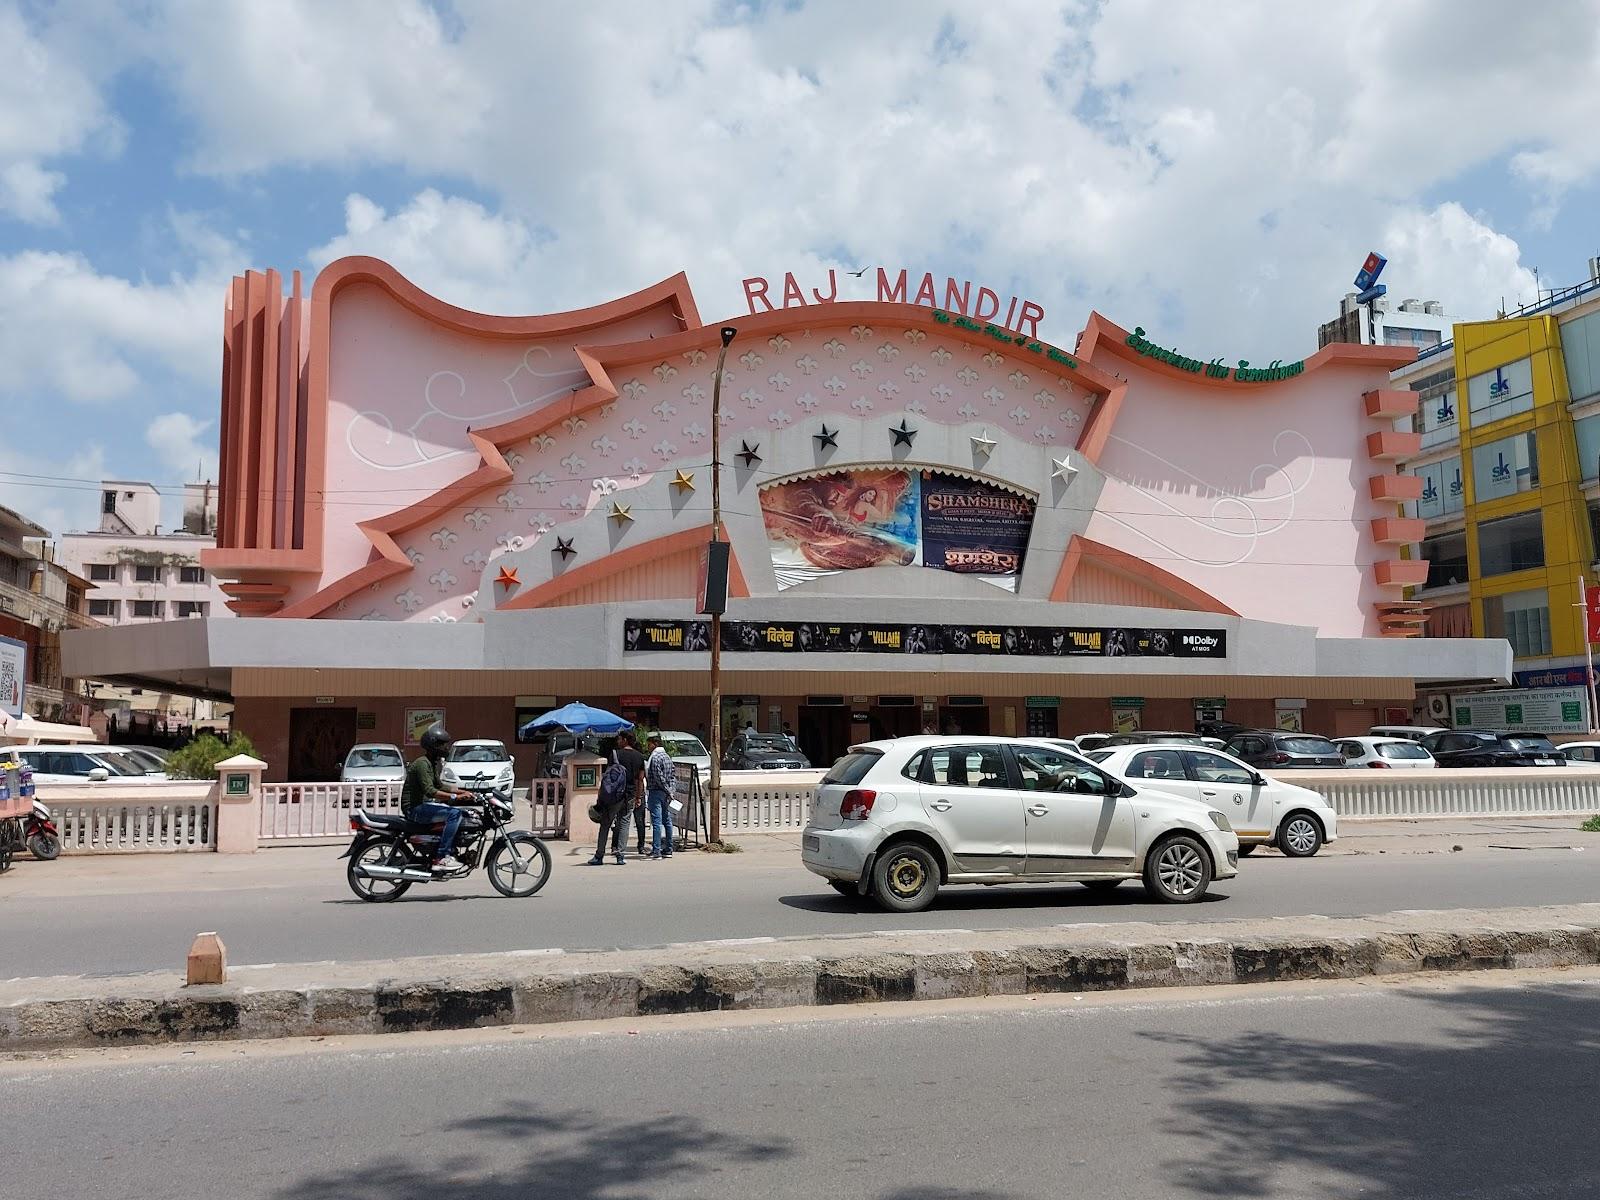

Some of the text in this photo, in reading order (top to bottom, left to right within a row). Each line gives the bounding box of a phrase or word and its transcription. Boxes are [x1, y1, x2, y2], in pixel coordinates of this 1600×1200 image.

[742, 267, 1046, 341] RAJ MANDIR
[1437, 394, 1454, 420] sk
[1492, 452, 1510, 478] sk
[1422, 476, 1437, 499] sk
[927, 494, 1032, 516] SHAMSHERA
[651, 627, 682, 643] VILLAIN
[766, 627, 794, 643] विलेन
[872, 630, 900, 644] VILLAIN
[976, 630, 1001, 645] विलेन
[1073, 631, 1101, 646] VILLAIN
[1194, 635, 1218, 647] Dolby
[232, 780, 244, 788] IN
